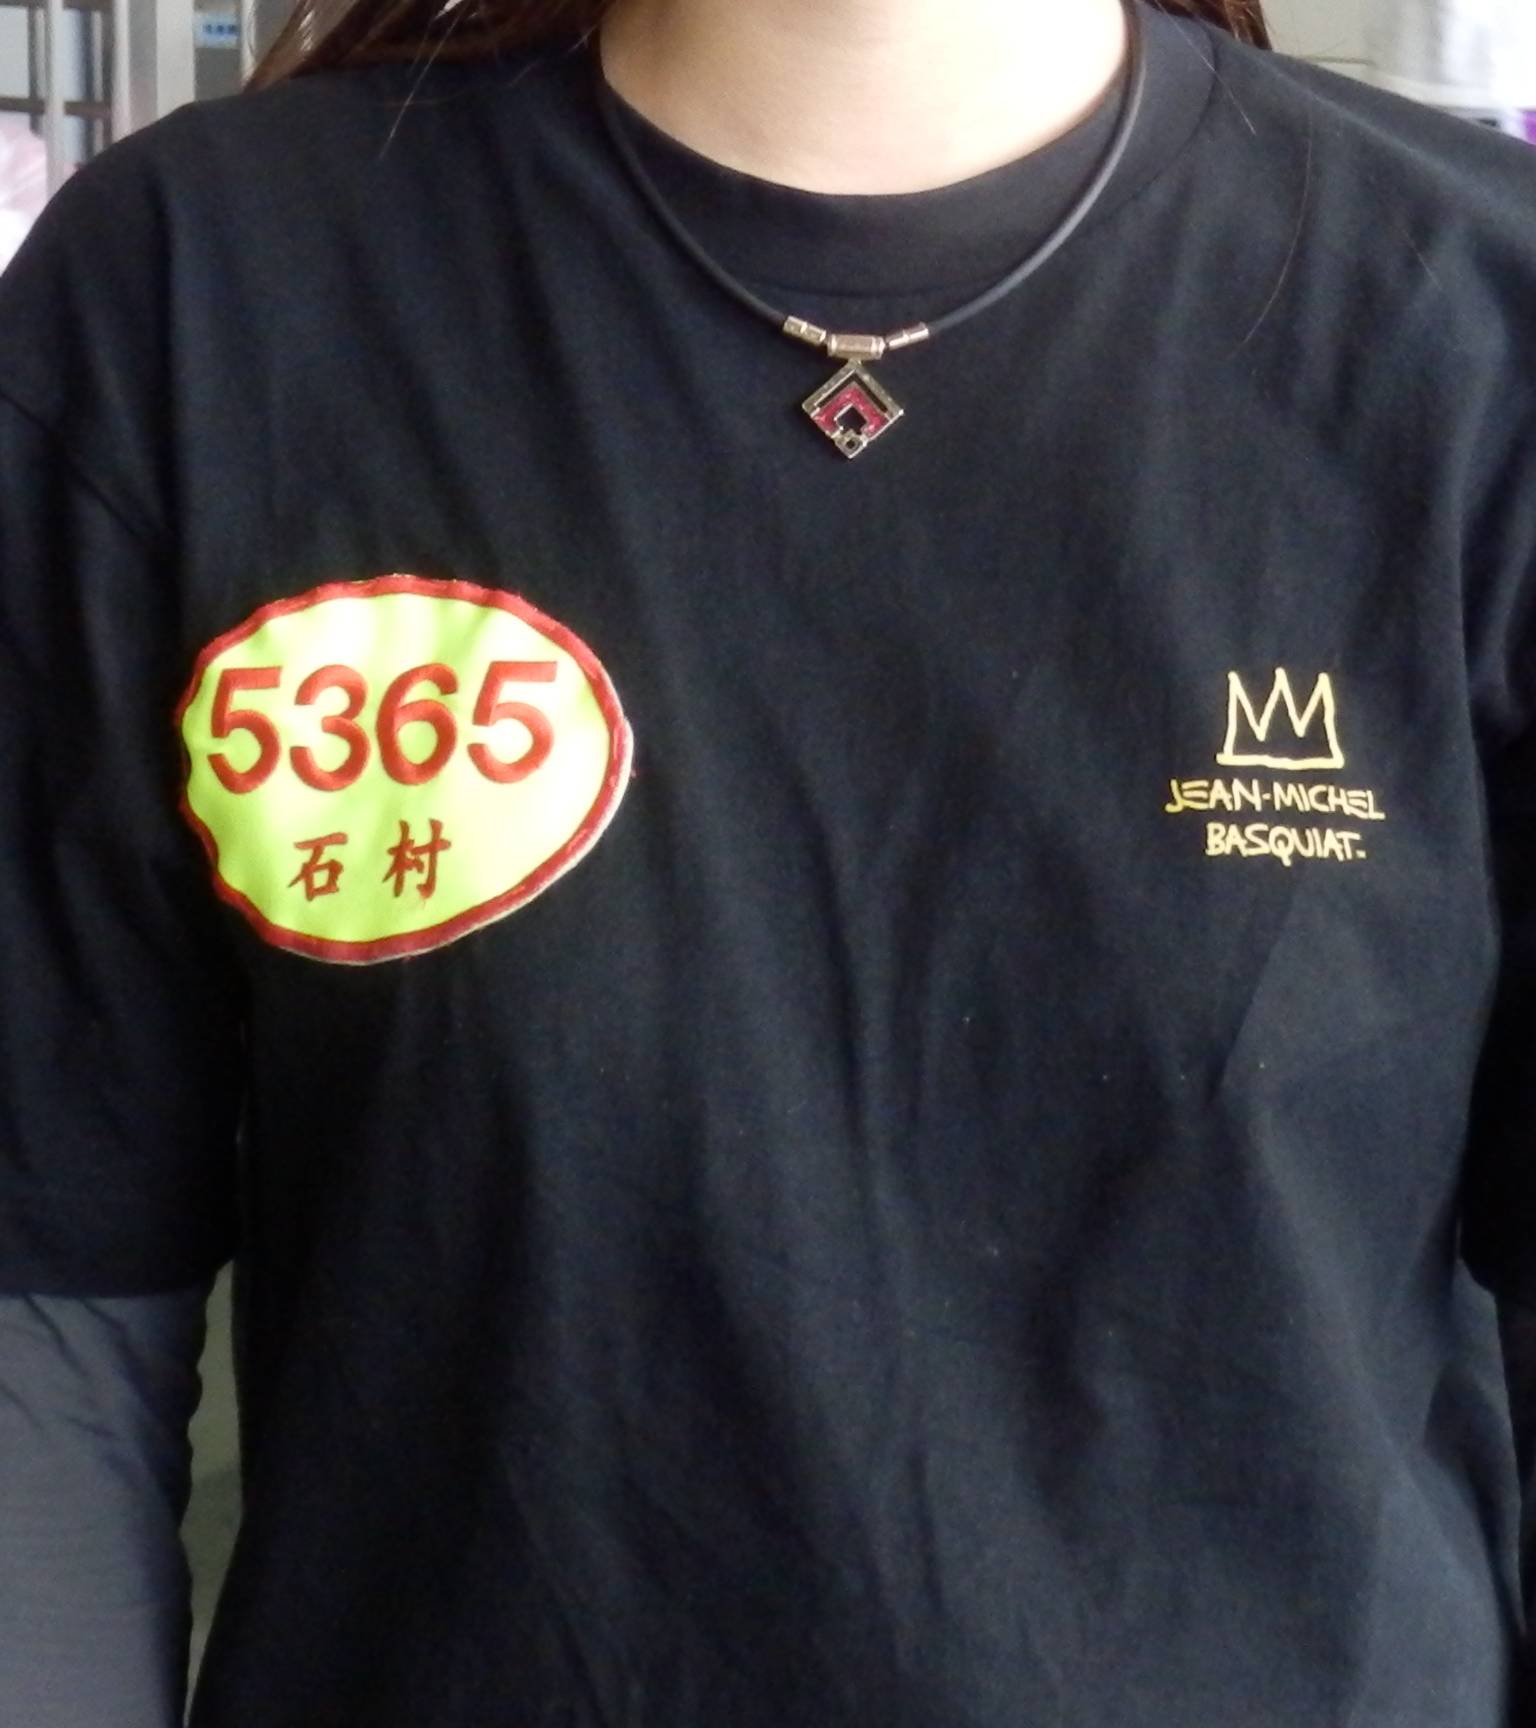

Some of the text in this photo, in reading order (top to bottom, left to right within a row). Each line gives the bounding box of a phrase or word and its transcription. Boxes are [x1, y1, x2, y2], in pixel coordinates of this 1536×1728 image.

[207, 661, 558, 794] 5365
[1165, 778, 1386, 821] JEAN-MICHEL
[287, 818, 452, 902] 石村
